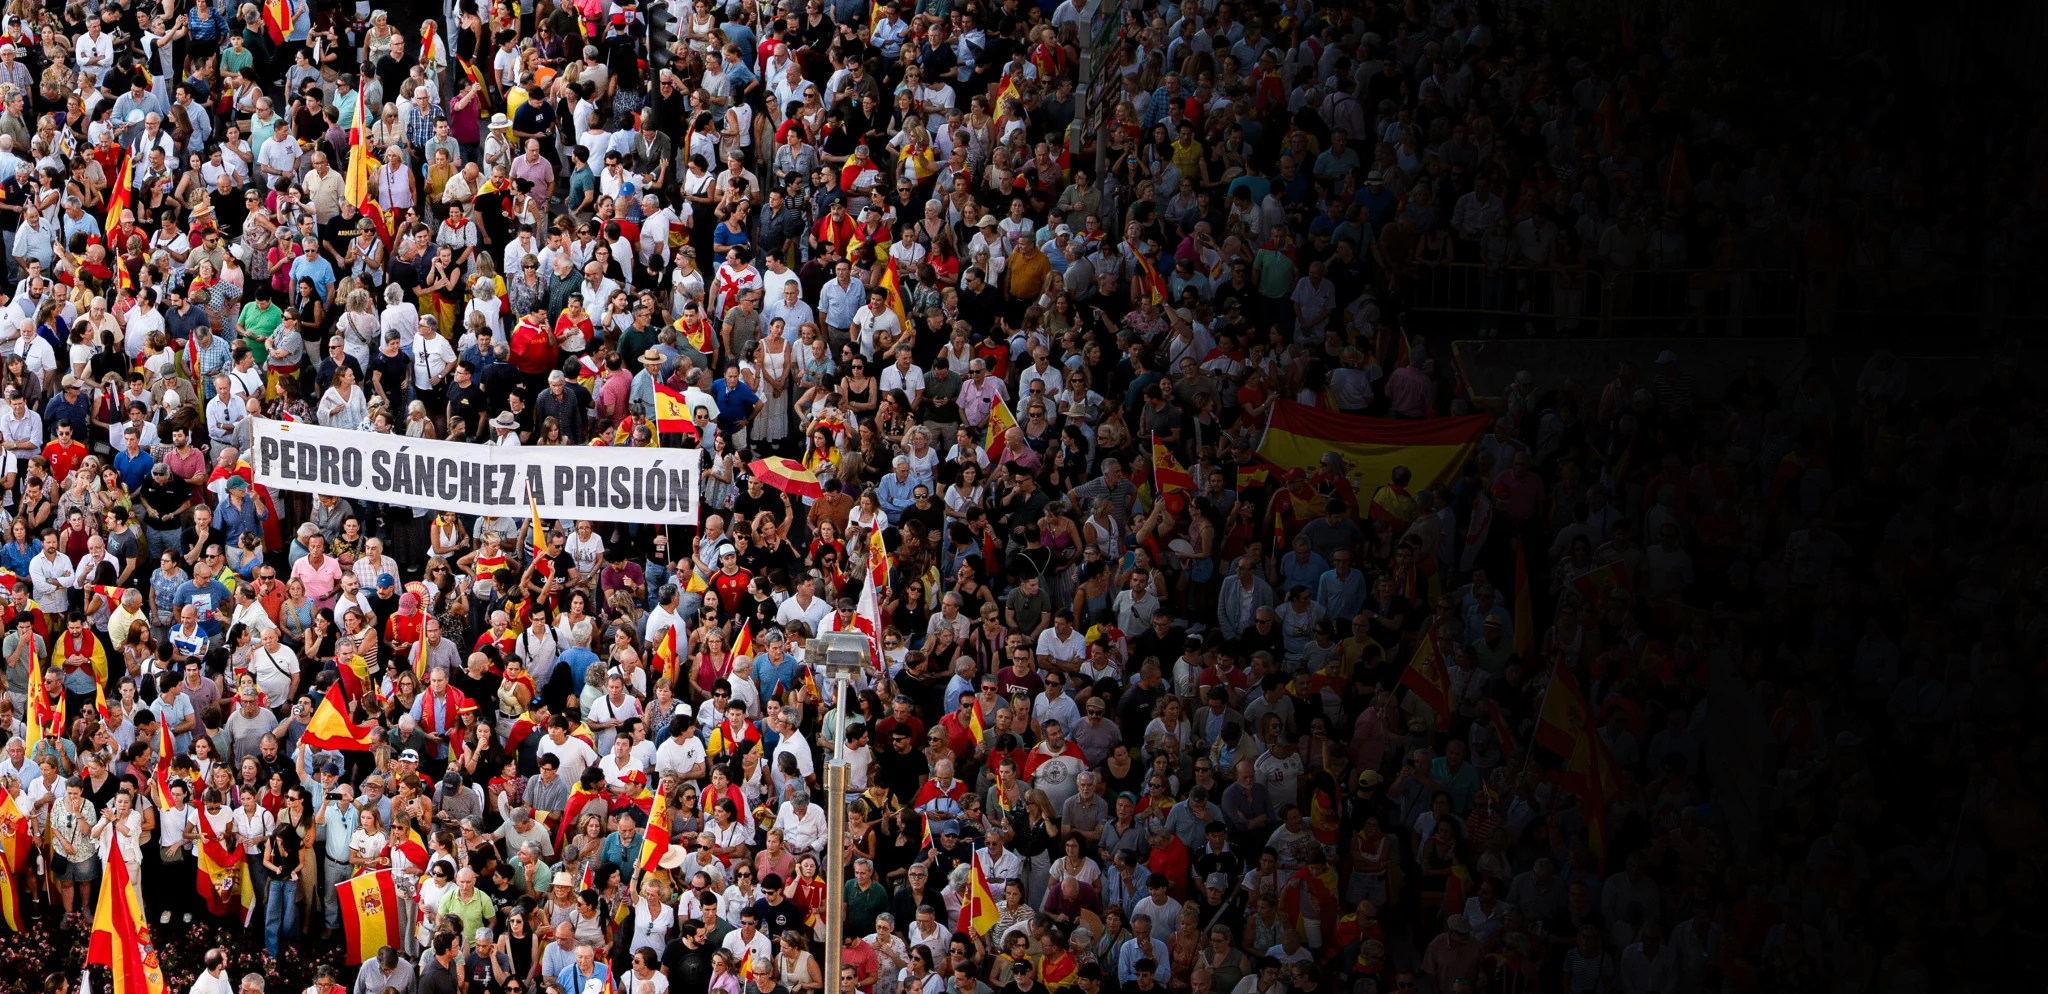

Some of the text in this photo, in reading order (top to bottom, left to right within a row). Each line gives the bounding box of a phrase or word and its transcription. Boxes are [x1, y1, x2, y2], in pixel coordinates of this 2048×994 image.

[51, 453, 58, 465] 5
[260, 436, 690, 513] PEDRO SÁNCHEZ A PRISIÓN
[731, 591, 738, 602] 7
[1006, 683, 1029, 695] VANS
[1274, 770, 1284, 782] 19
